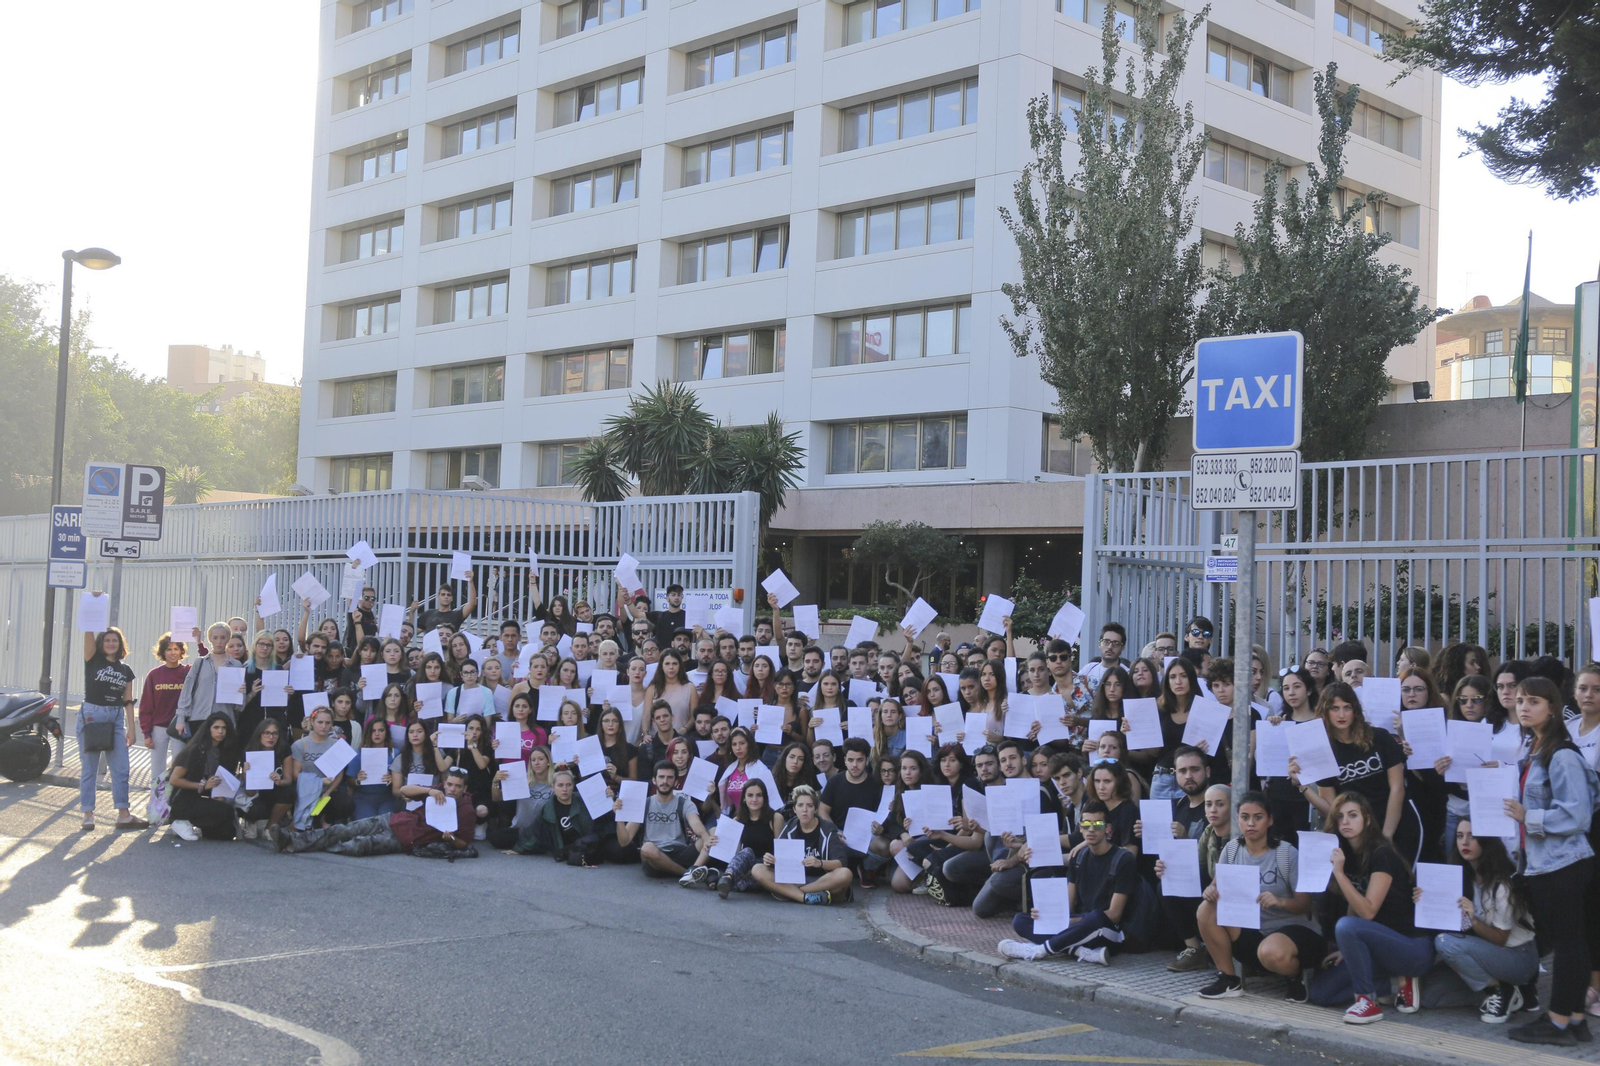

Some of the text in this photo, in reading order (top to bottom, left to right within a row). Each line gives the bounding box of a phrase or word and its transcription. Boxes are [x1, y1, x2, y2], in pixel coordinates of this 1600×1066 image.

[1201, 374, 1292, 411] TAXI
[1196, 458, 1237, 475] 952 333 333
[1250, 457, 1292, 474] 952 320 000
[130, 466, 161, 506] P
[1250, 487, 1291, 502] 952 040 404
[1196, 488, 1236, 503] 952 040 804
[1224, 538, 1236, 548] 47
